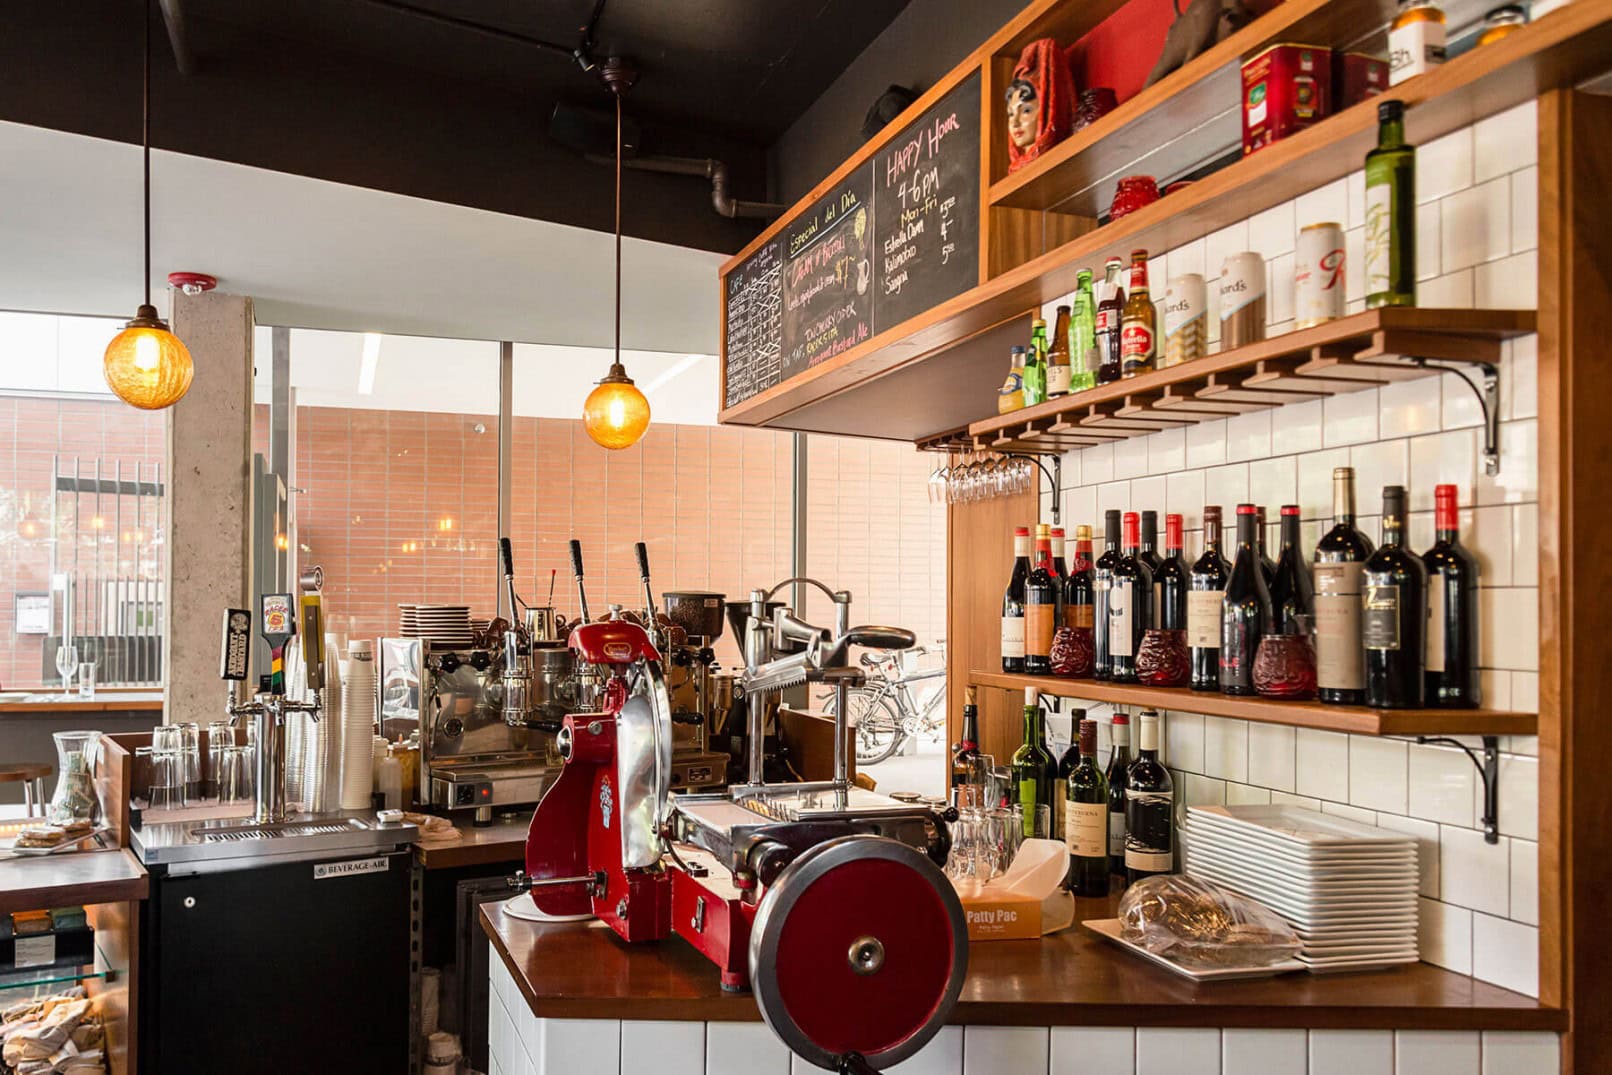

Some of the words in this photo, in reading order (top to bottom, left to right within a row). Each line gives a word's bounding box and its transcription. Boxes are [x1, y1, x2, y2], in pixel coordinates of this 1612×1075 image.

[887, 130, 923, 188] HAPPY
[825, 203, 836, 223] del
[901, 194, 937, 229] Mon-Fri
[966, 910, 995, 924] Patty
[997, 909, 1017, 922] Pac
